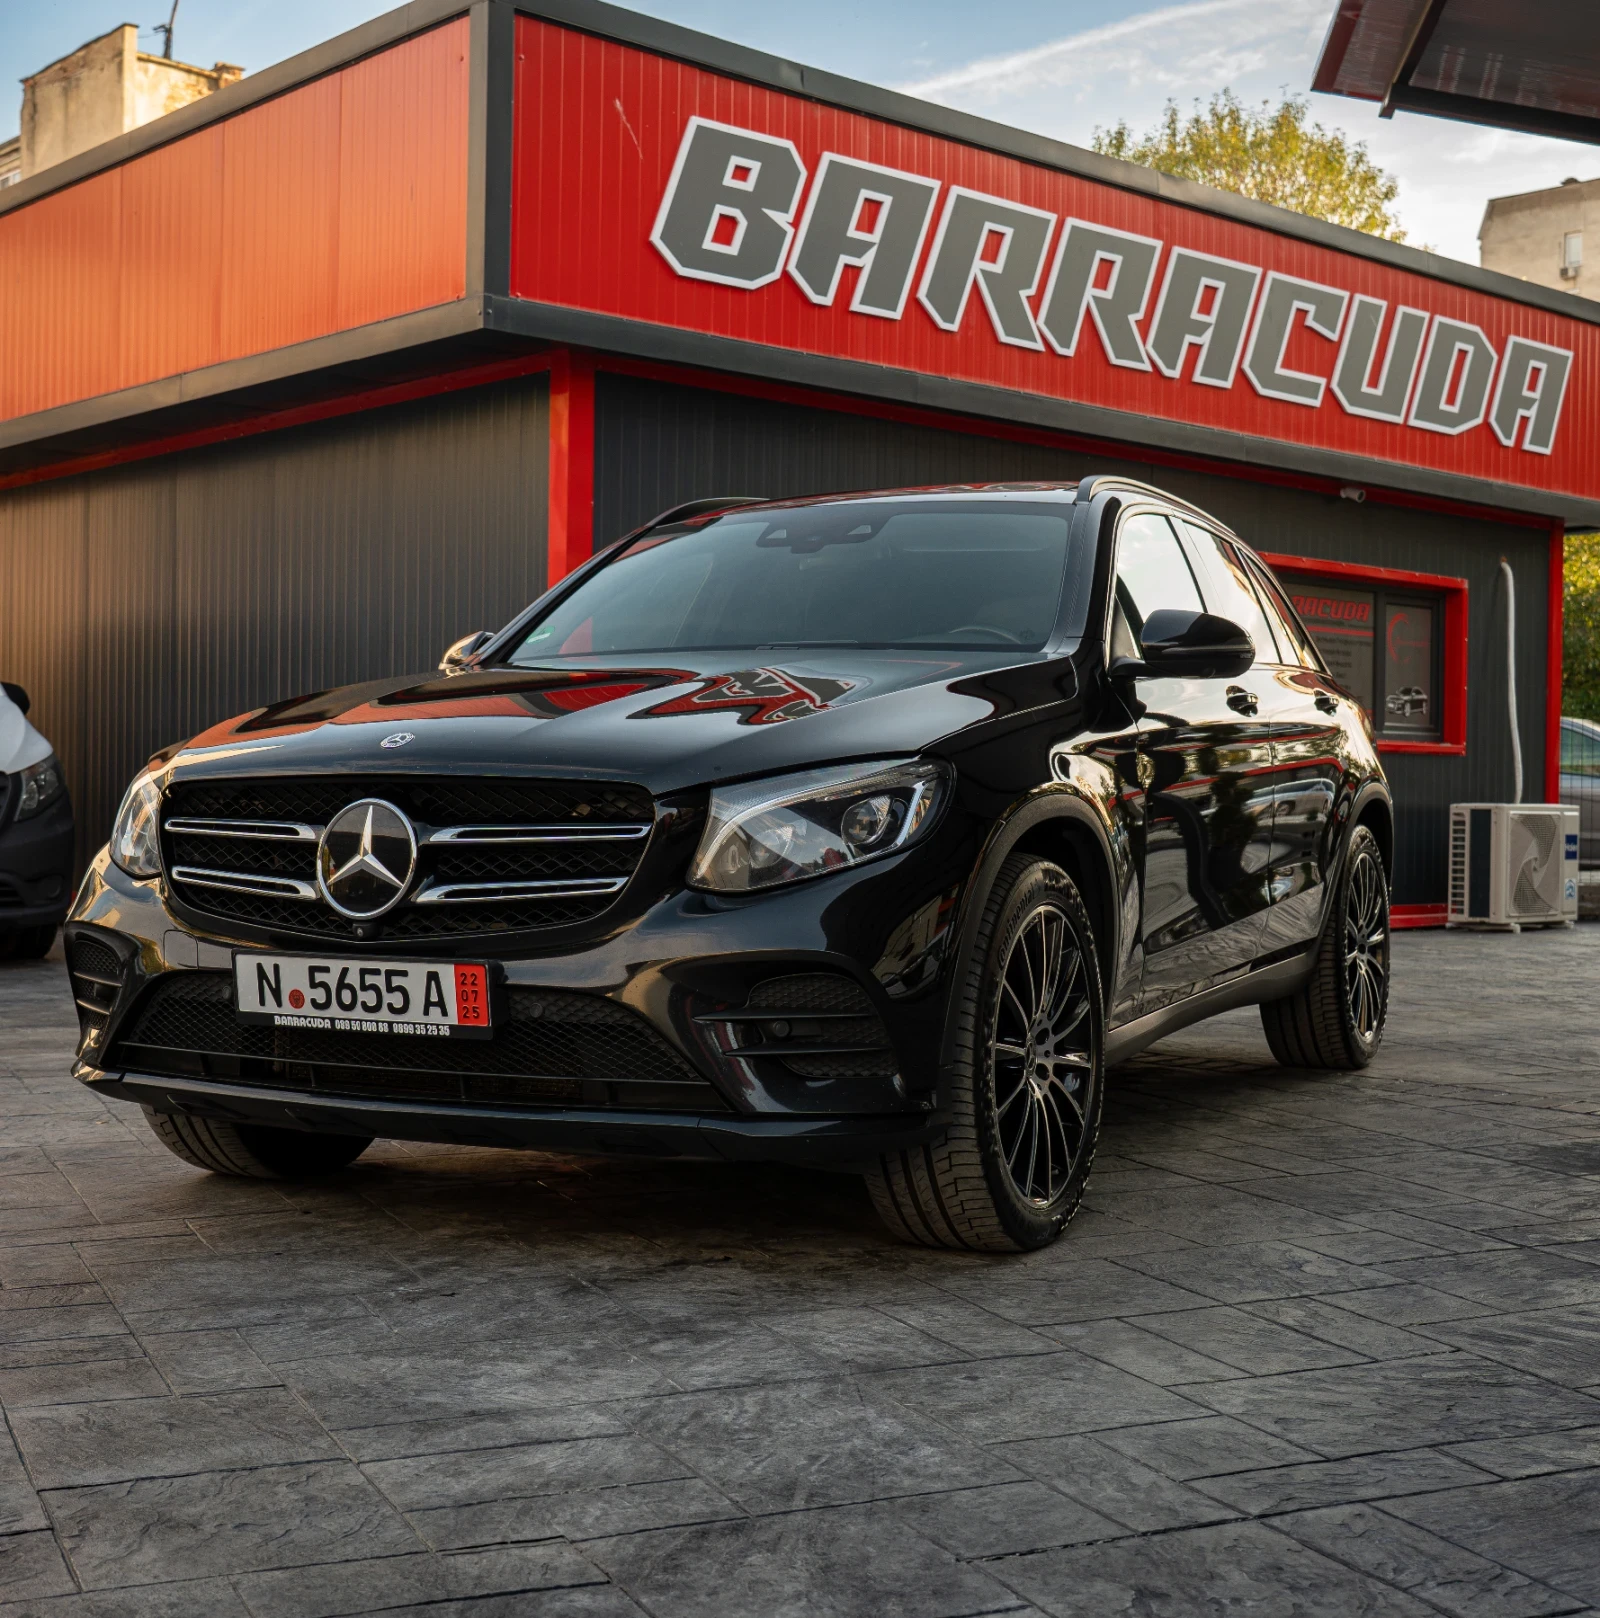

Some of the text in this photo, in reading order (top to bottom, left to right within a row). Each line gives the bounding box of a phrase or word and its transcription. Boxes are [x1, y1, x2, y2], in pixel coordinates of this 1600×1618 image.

[650, 115, 1574, 456] BARRACUDA
[1291, 596, 1370, 622] RACUDA
[256, 962, 449, 1018] N 5655 A
[460, 972, 479, 986] 22
[461, 989, 479, 1003] 07
[462, 1005, 480, 1019] 25
[274, 1015, 332, 1029] BARRACUDA
[415, 1024, 426, 1035] 35
[427, 1025, 438, 1036] 25
[439, 1025, 450, 1037] 35
